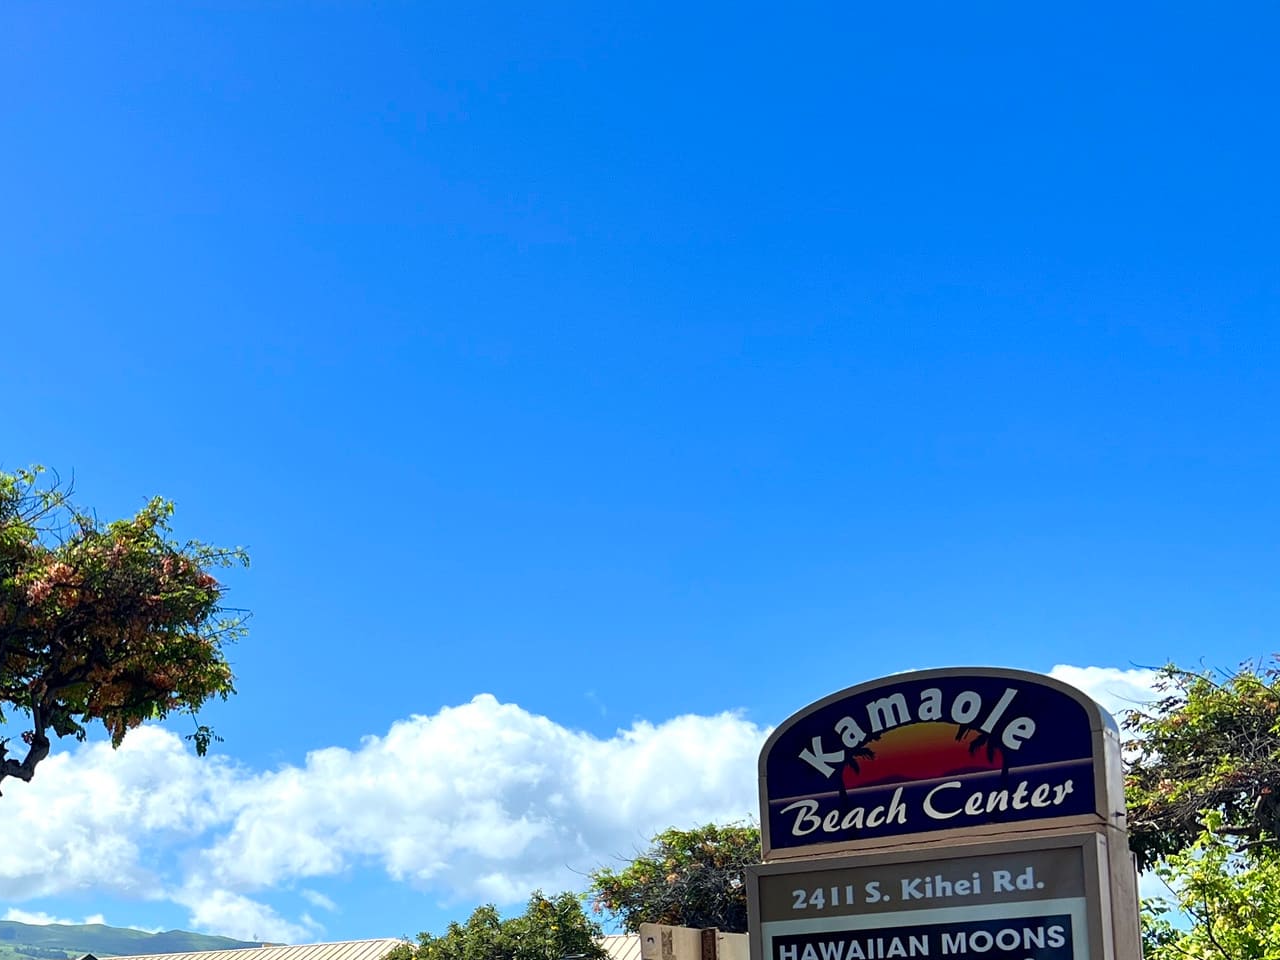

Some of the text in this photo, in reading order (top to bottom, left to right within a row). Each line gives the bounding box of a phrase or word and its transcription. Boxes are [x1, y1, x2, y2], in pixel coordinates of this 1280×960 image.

[799, 687, 1036, 778] Kamaole
[780, 781, 1074, 836] Beach Center
[793, 867, 1044, 909] 2411 S. Kihei Rd.
[942, 926, 1065, 954] MOONS
